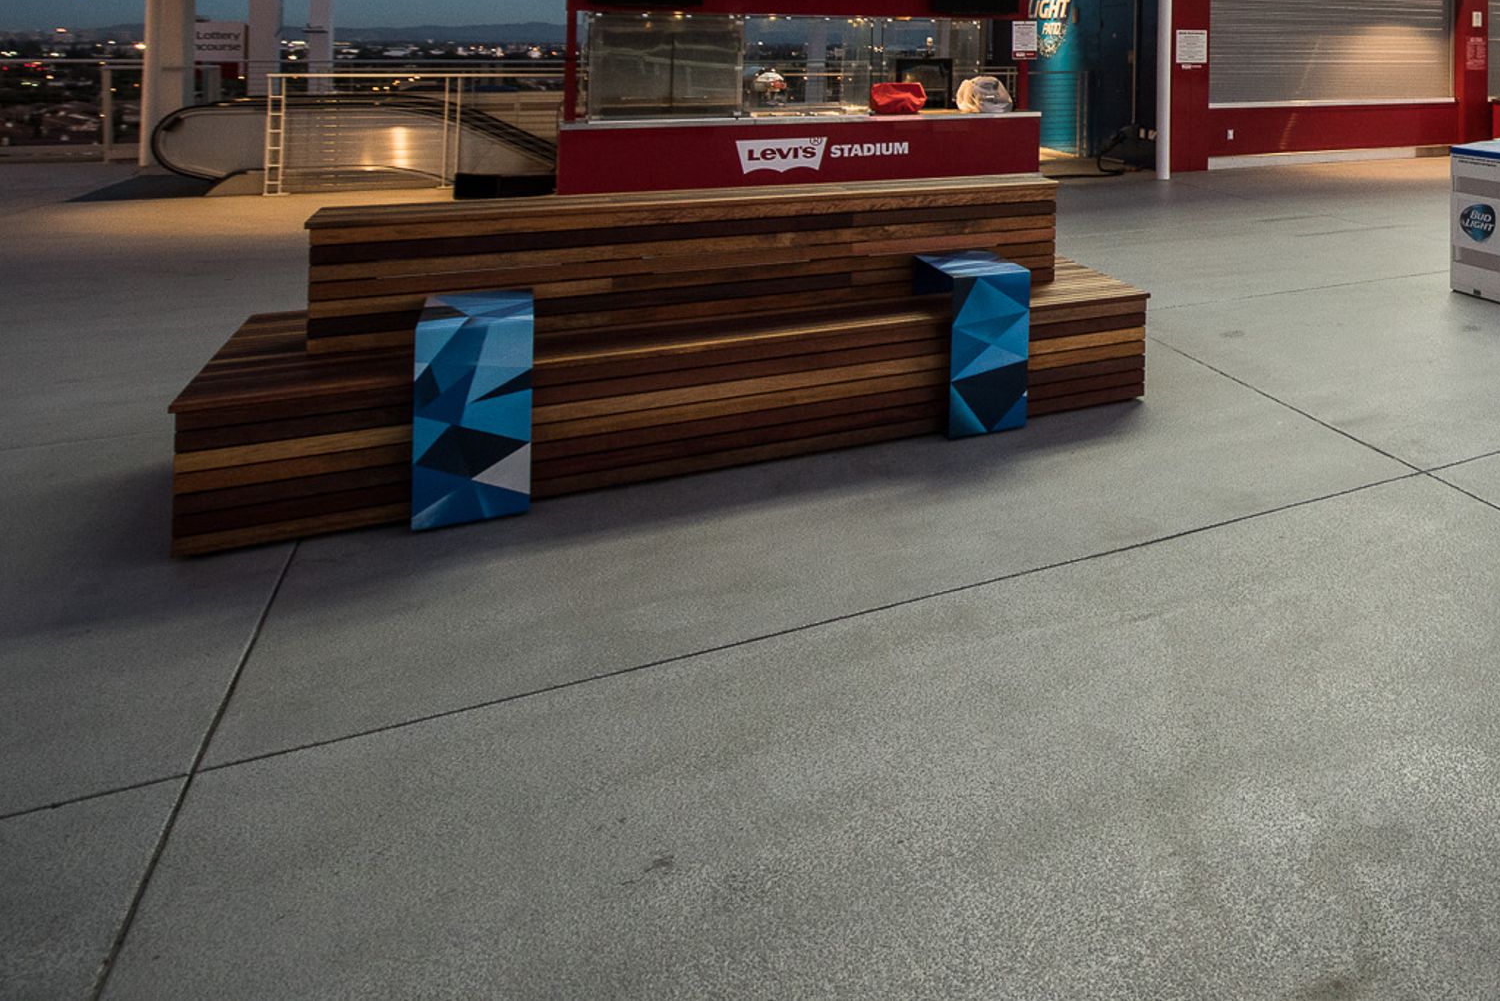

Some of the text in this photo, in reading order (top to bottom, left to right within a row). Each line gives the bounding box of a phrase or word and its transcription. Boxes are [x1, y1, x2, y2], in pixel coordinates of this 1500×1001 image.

[196, 31, 241, 41] Lottery
[830, 142, 909, 158] STADIUM
[1470, 210, 1492, 222] BUD
[1464, 218, 1494, 232] LIGHT
